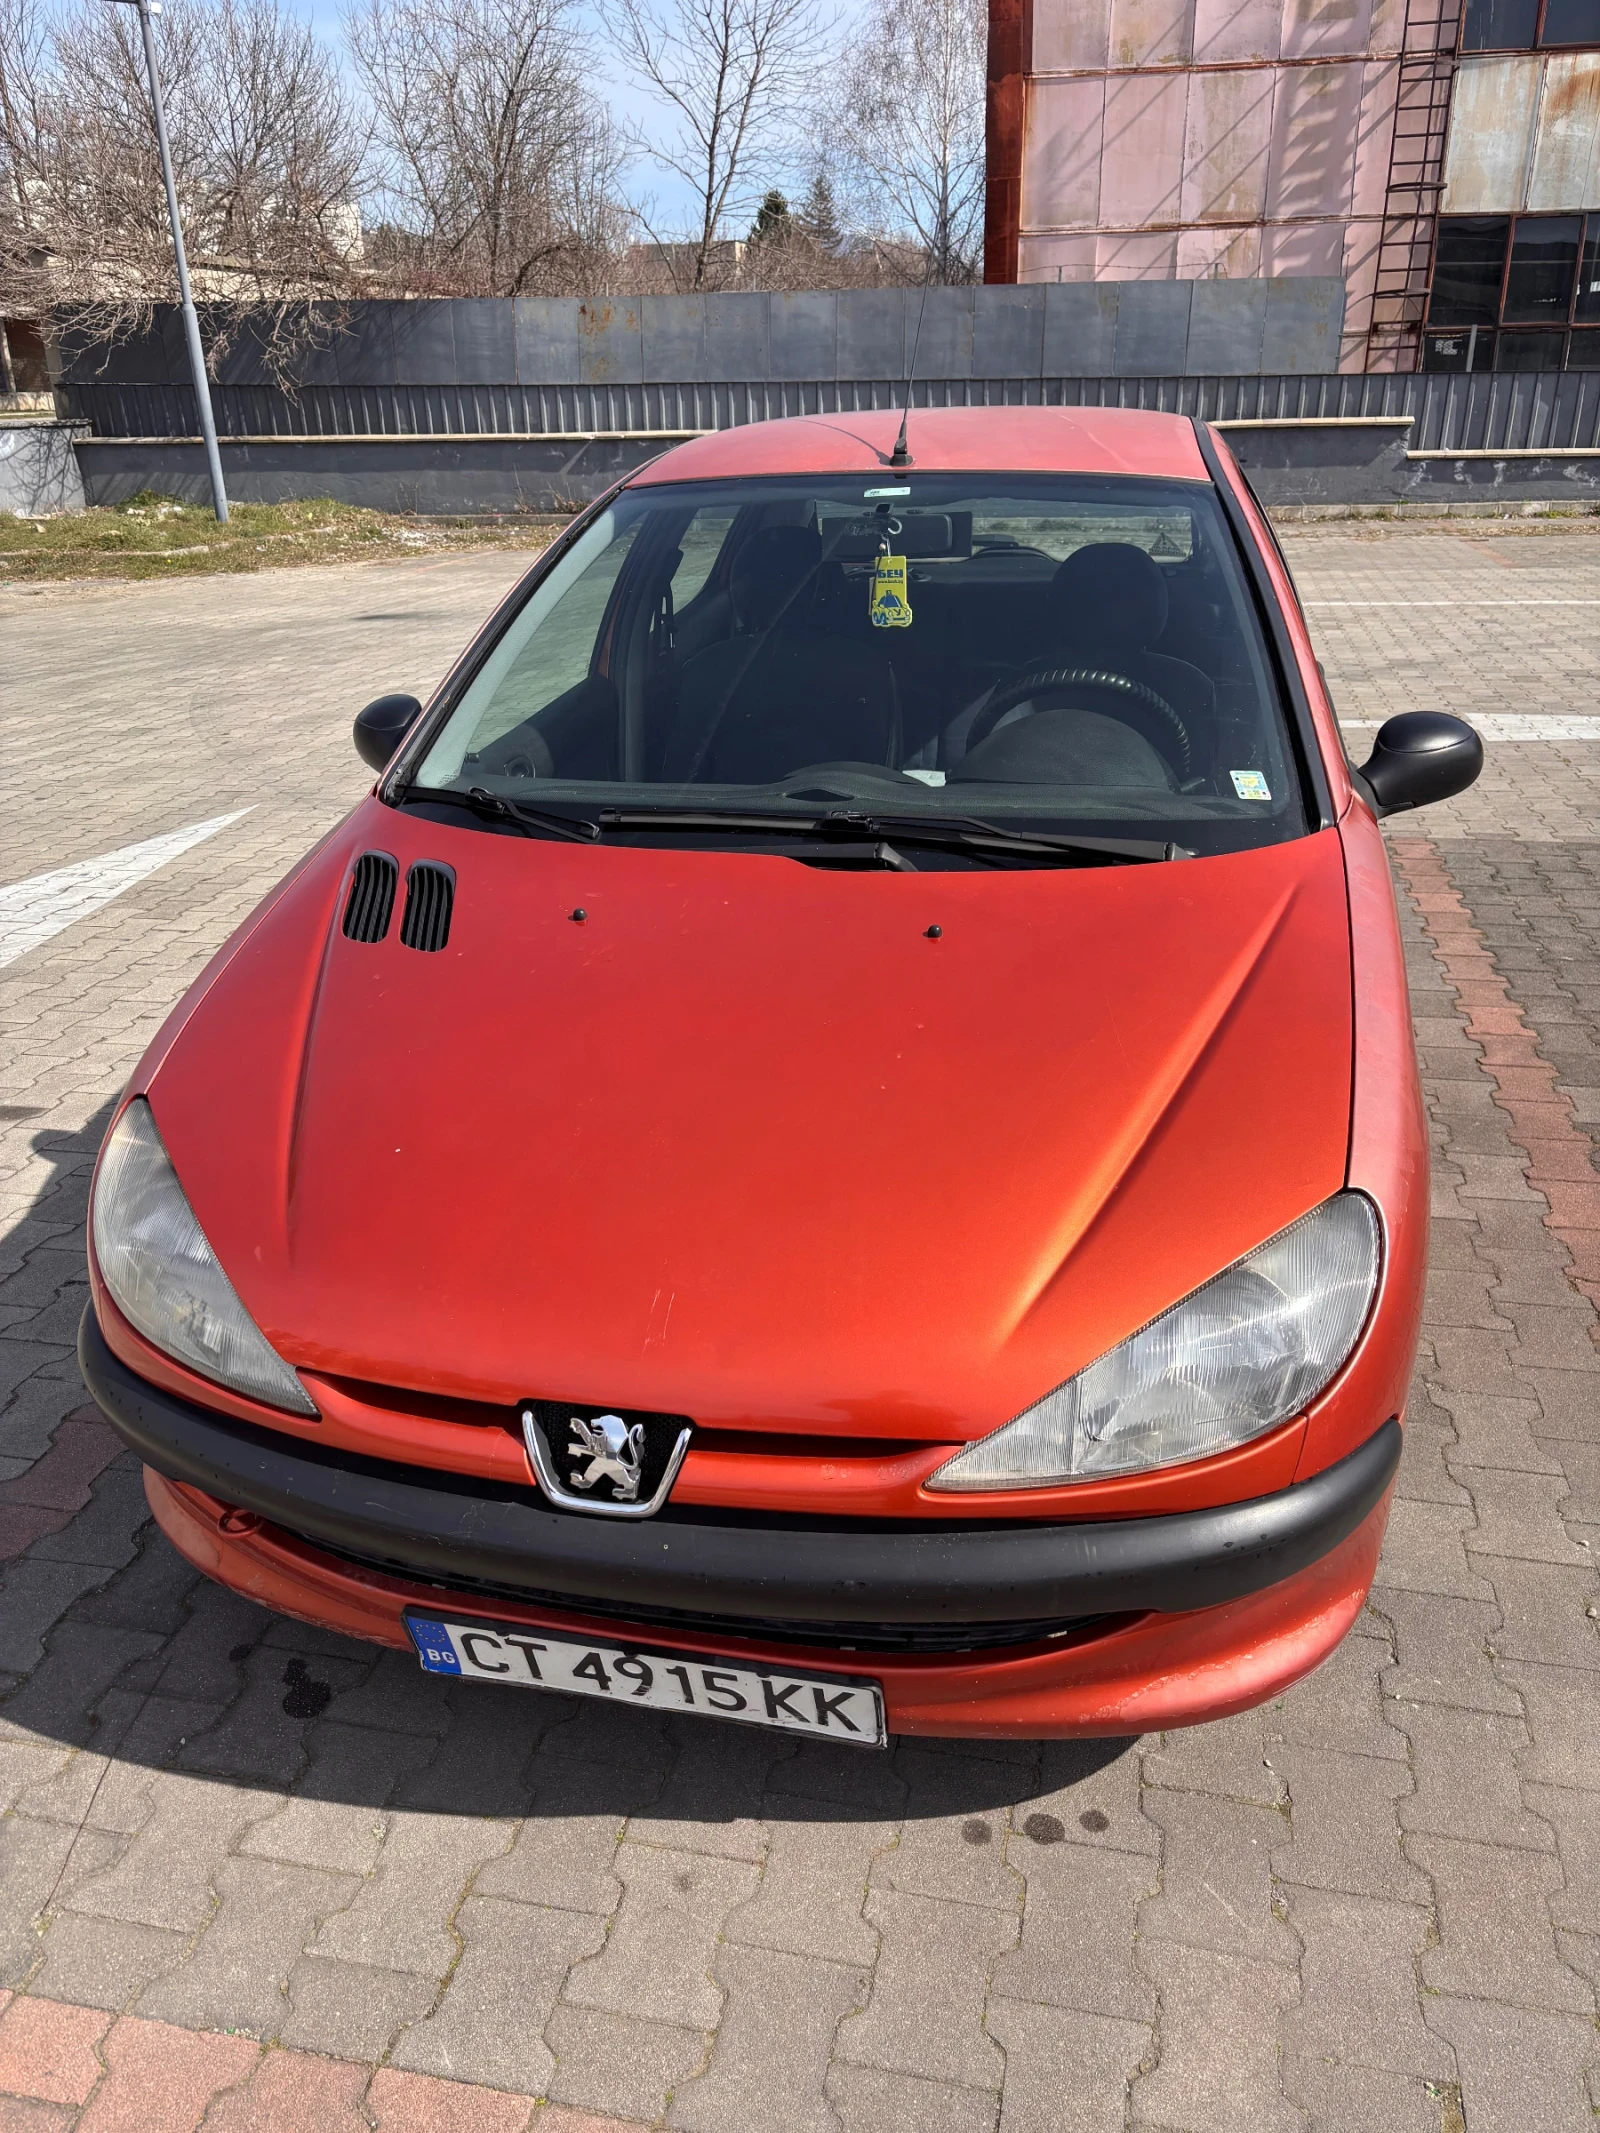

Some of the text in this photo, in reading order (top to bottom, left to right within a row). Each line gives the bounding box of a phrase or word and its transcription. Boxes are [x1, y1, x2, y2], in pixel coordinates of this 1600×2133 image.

[427, 1648, 456, 1664] BG
[460, 1632, 861, 1732] CT 4915 KK
